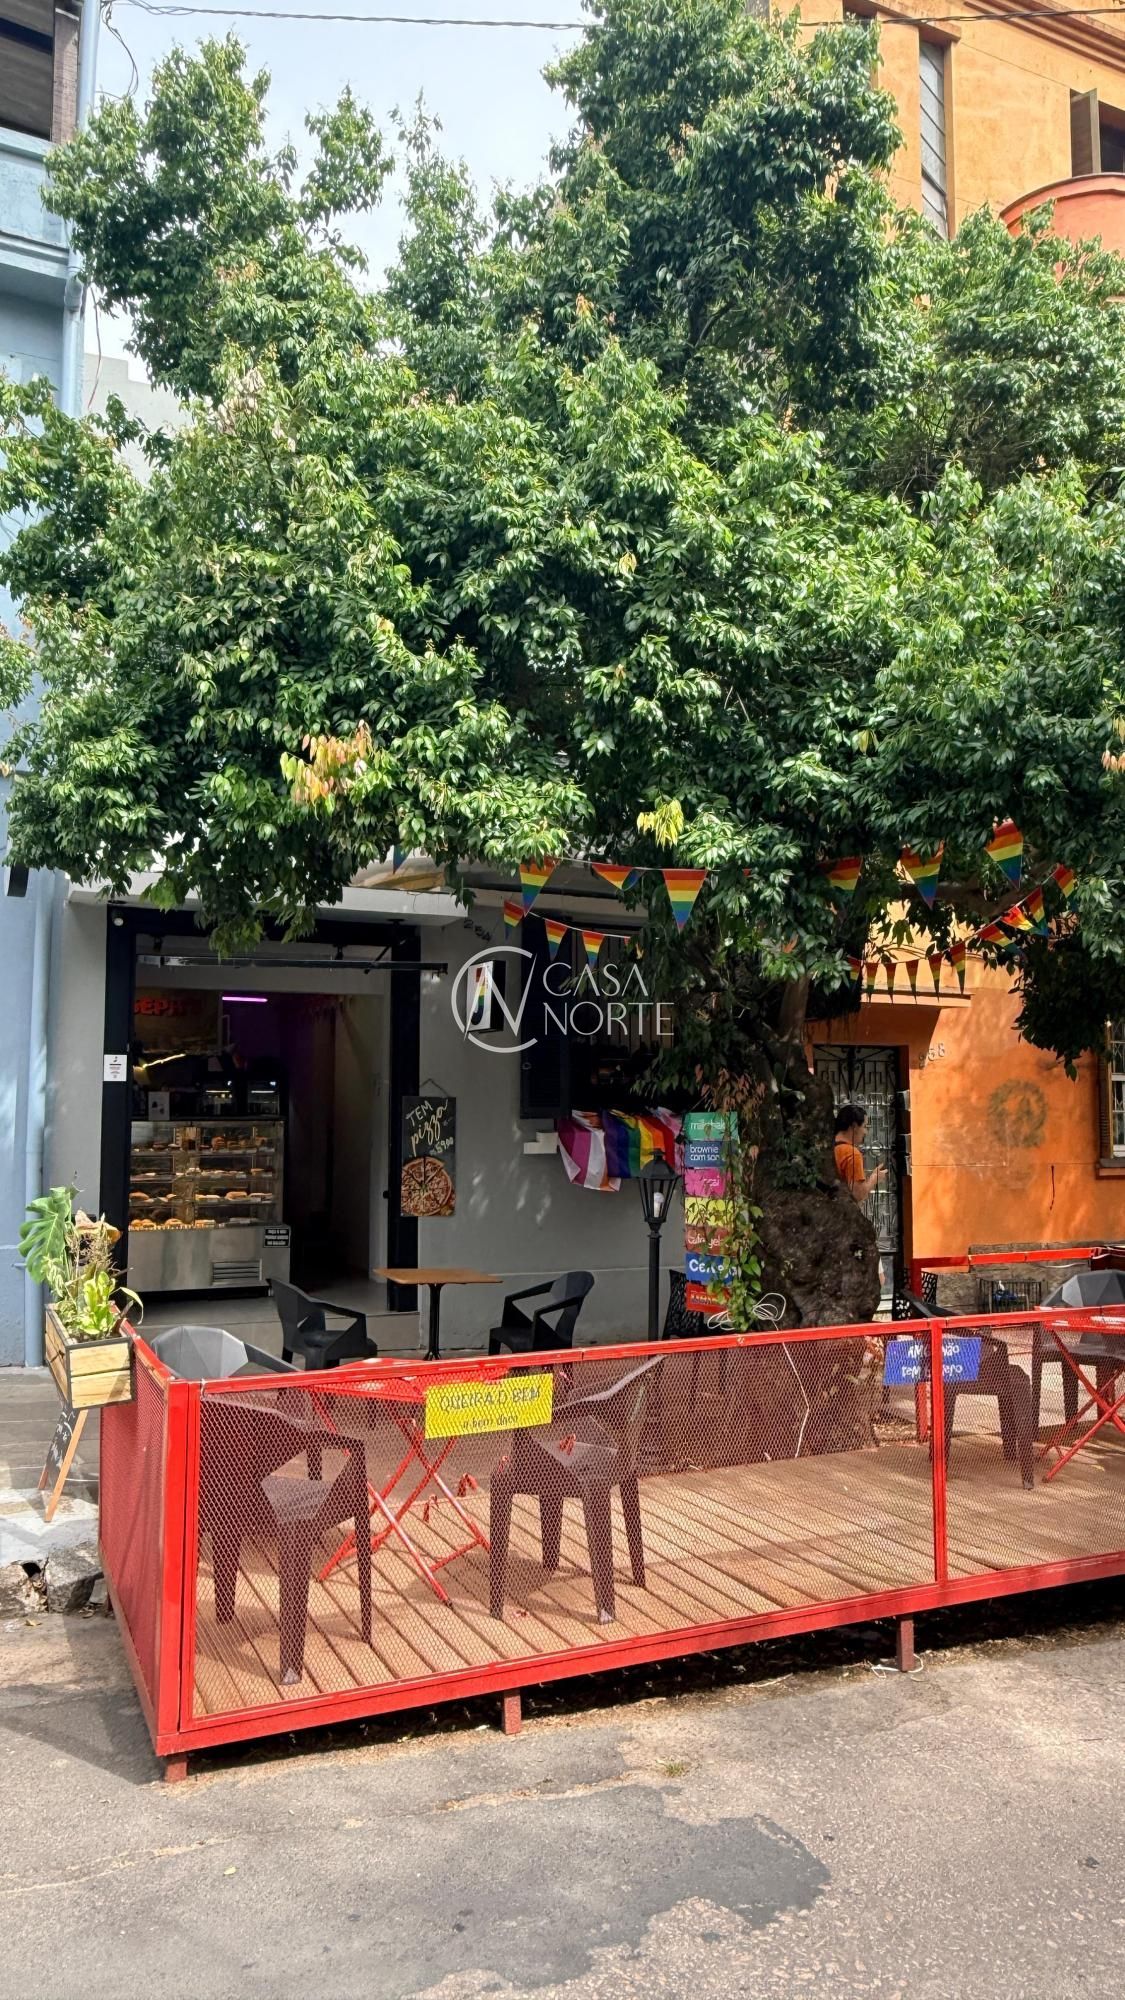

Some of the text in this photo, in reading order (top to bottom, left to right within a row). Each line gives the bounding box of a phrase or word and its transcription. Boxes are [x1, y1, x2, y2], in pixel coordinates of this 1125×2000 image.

[405, 1100, 433, 1127] TEM
[411, 1099, 449, 1157] pizza
[690, 1144, 719, 1154] brownie
